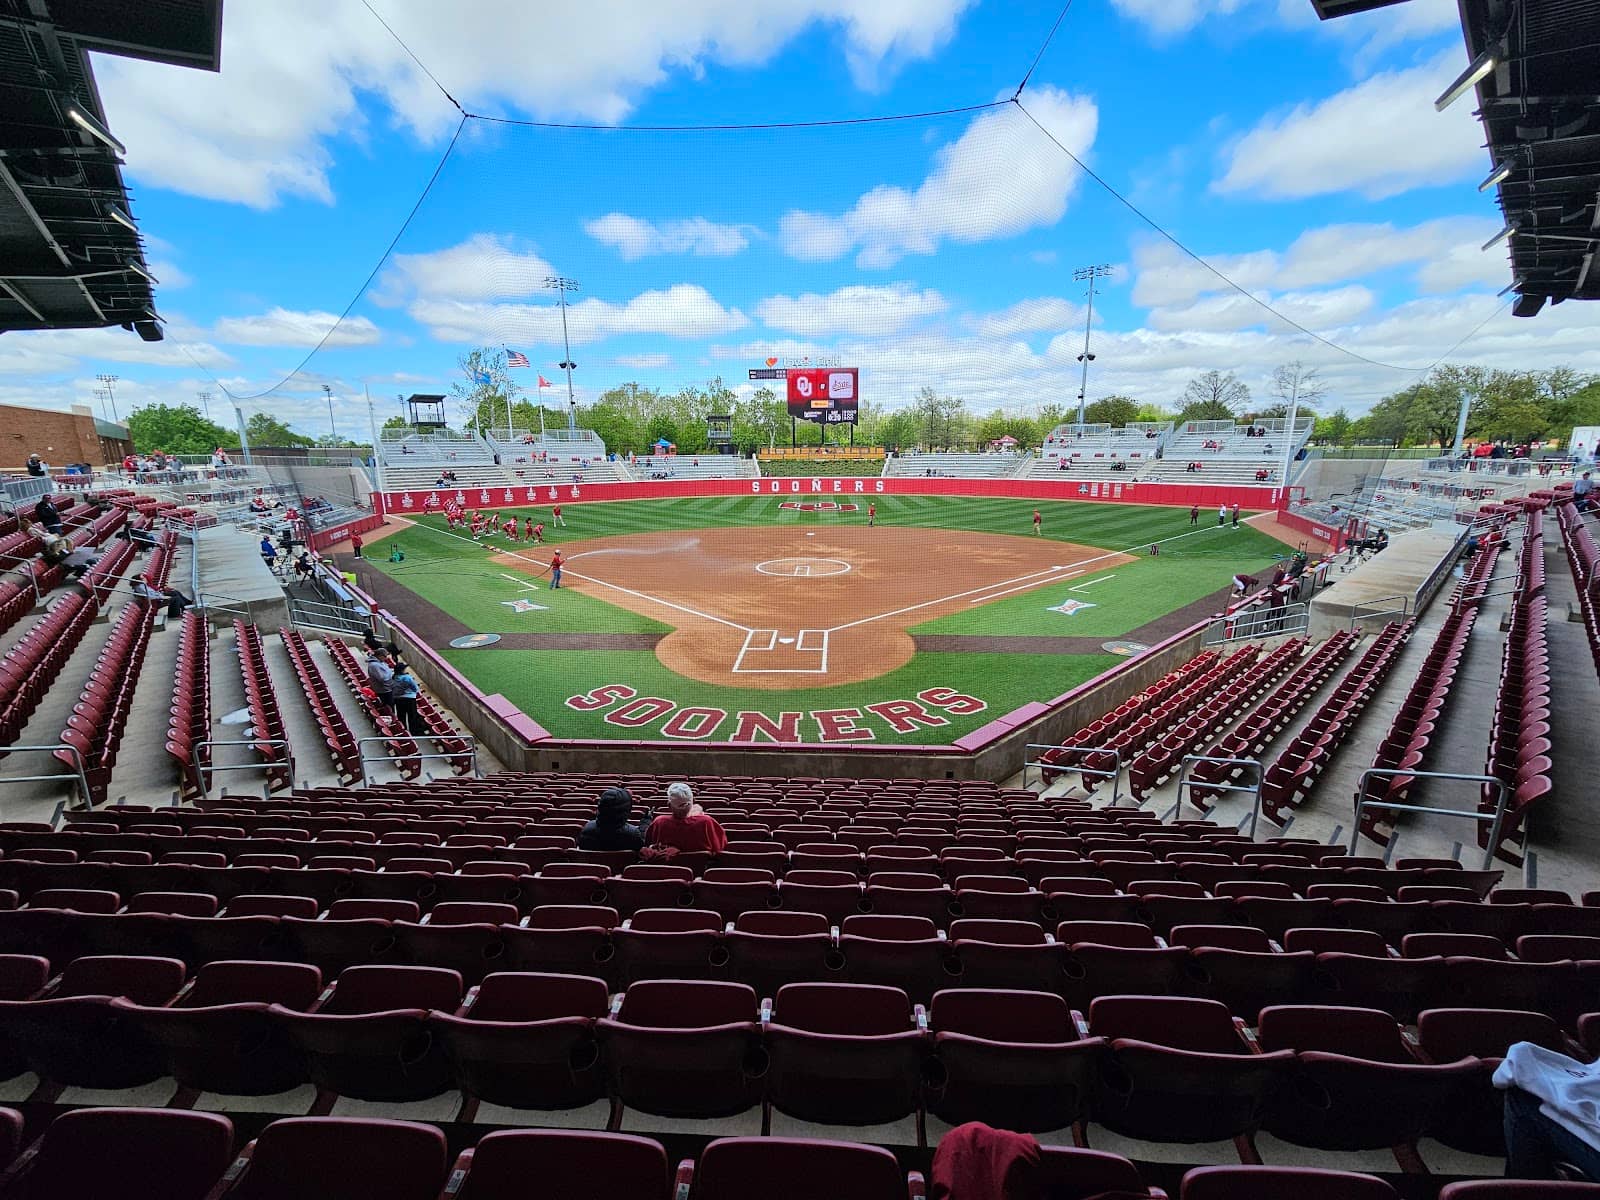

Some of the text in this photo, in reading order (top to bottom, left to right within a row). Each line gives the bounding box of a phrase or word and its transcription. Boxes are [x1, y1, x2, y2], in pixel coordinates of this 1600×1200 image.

[797, 376, 813, 397] OU
[752, 480, 884, 492] SOONERS
[565, 684, 988, 742] SOONERS
